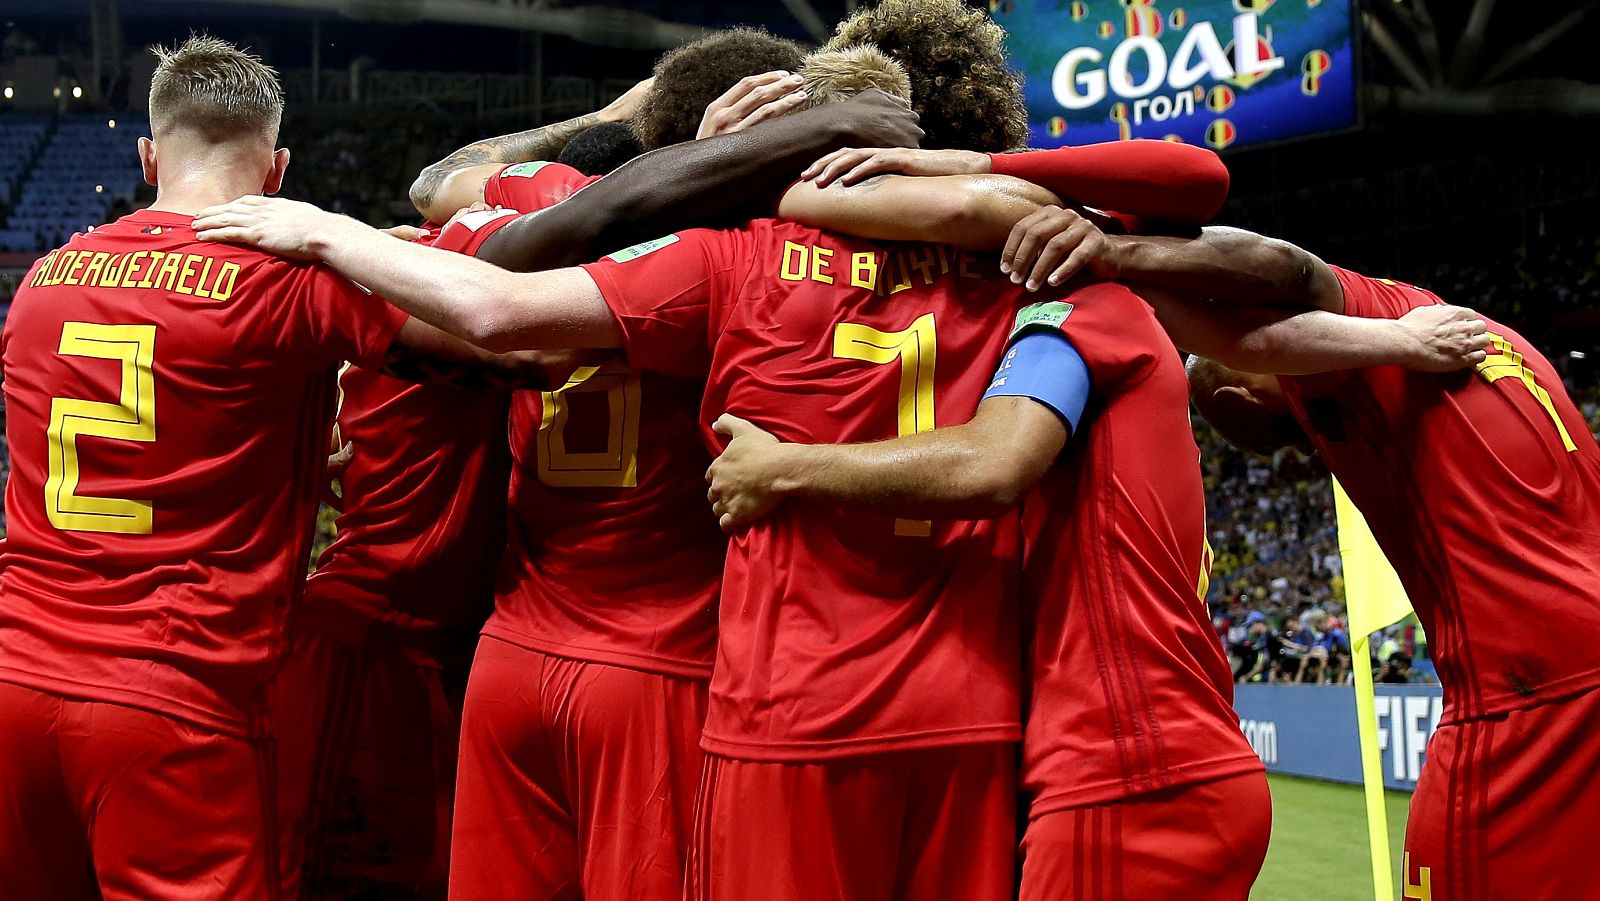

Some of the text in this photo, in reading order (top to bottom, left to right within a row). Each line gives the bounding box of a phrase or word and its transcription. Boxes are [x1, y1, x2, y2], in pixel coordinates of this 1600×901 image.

[1051, 12, 1285, 110] GOAL
[1133, 91, 1195, 126] ГОЛ
[29, 250, 240, 301] ALDERWEIRELD
[780, 240, 833, 285] DE
[44, 321, 157, 534] 2
[832, 312, 937, 537] 7
[1374, 694, 1443, 781] FIF
